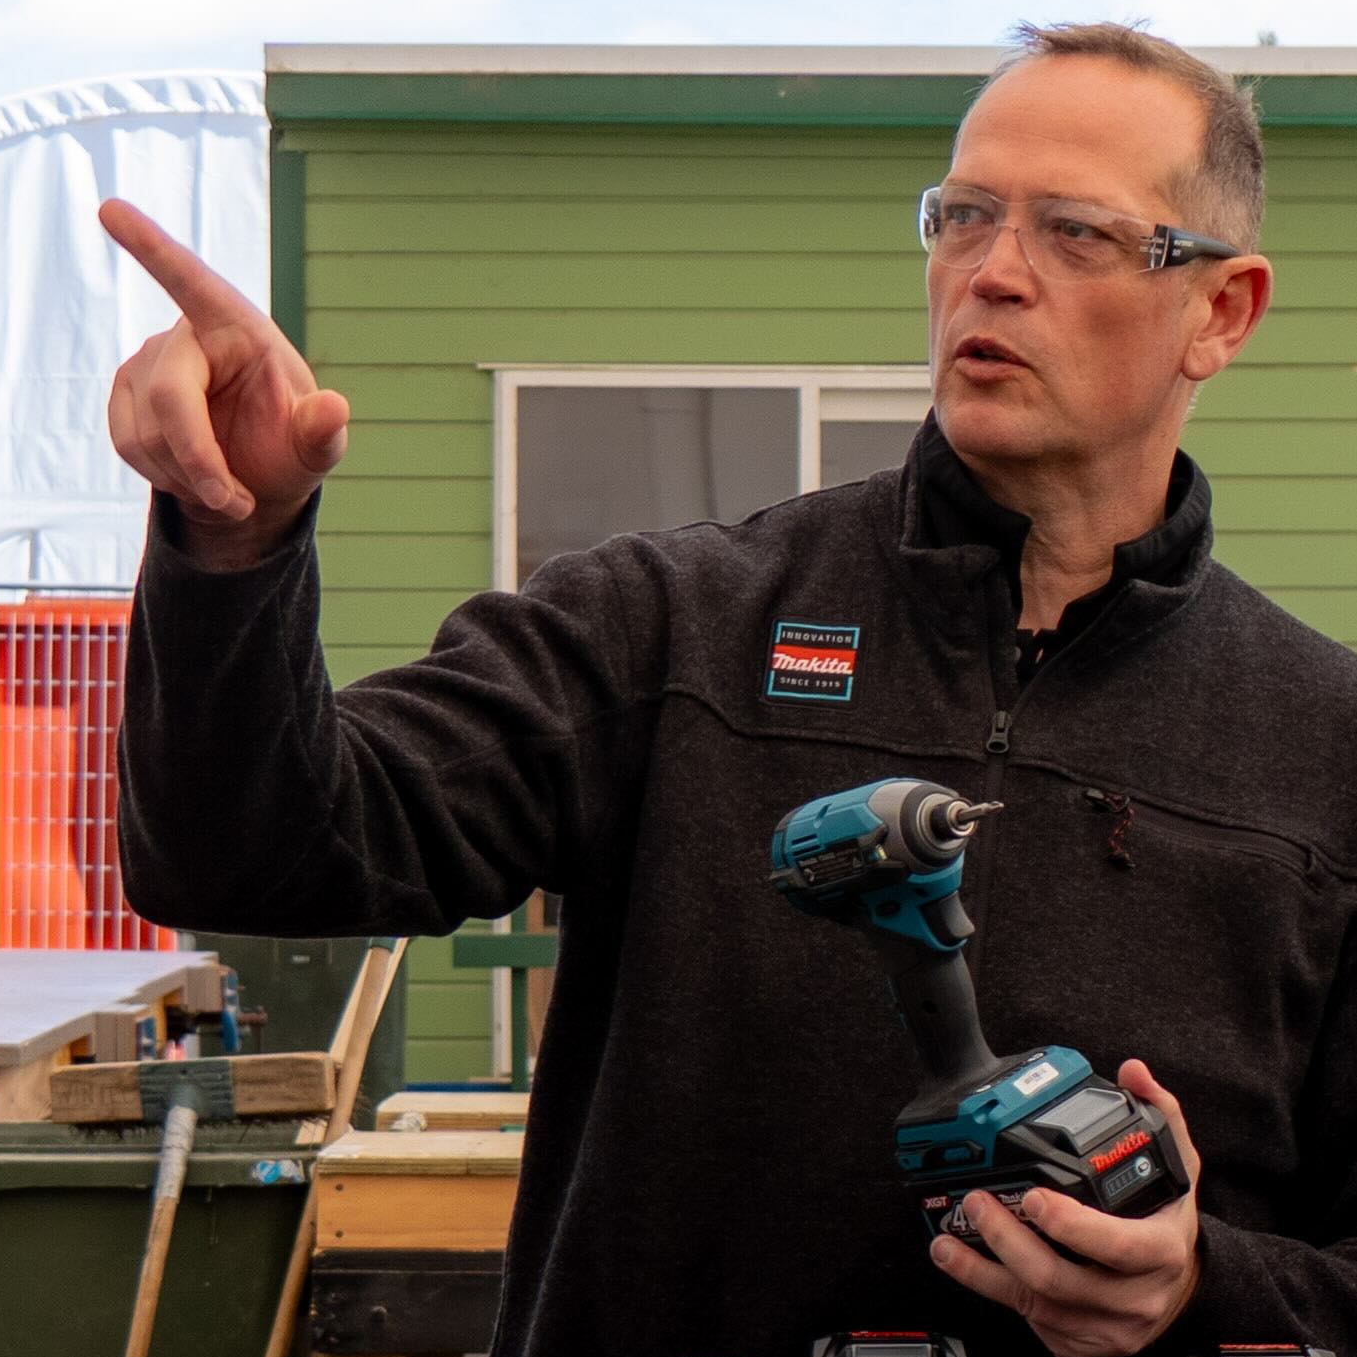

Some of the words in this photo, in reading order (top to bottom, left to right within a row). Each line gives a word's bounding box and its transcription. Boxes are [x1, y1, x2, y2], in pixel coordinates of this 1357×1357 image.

[782, 630, 852, 643] INNOVATION
[779, 677, 809, 686] SINCE
[924, 1195, 948, 1209] XGT
